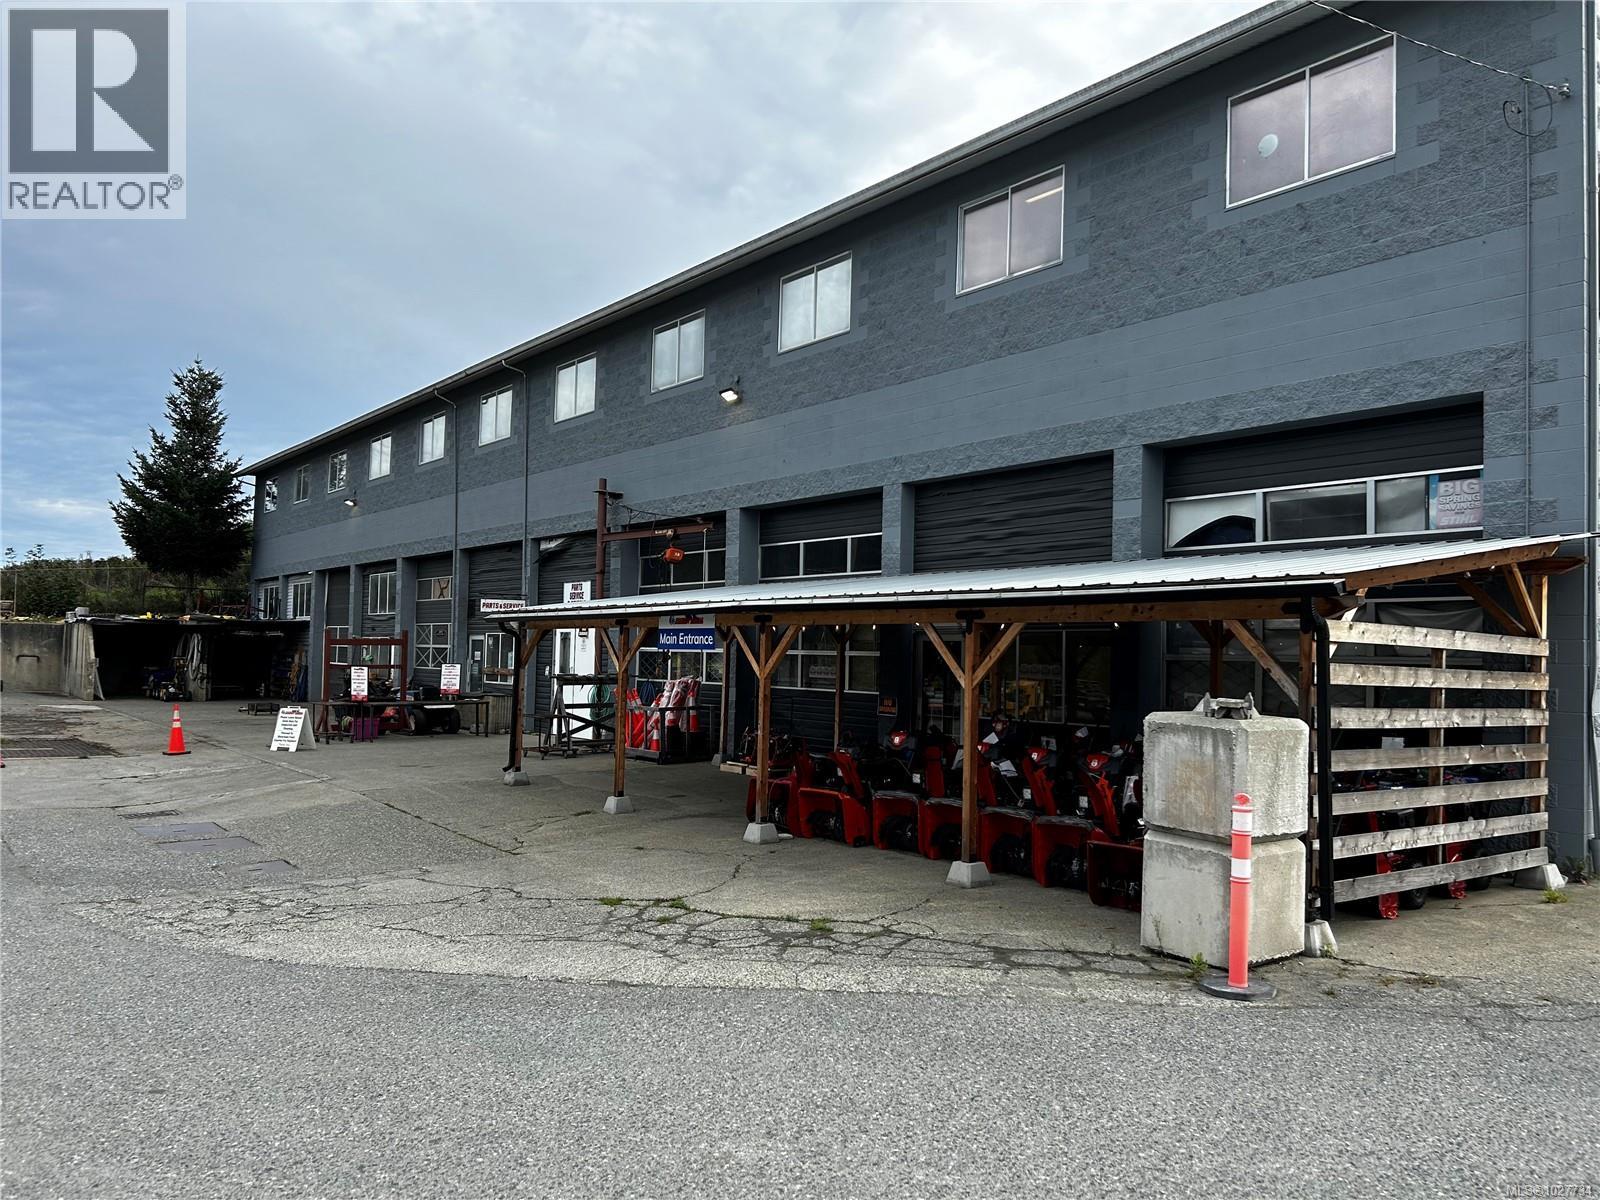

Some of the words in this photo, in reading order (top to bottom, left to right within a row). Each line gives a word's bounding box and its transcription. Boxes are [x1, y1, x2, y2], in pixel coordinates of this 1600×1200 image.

[1439, 479, 1480, 497] BIG
[1439, 494, 1481, 504] SPRING
[1439, 502, 1481, 512] SAVINGS
[1439, 514, 1478, 526] STIHL
[571, 583, 583, 591] PARTS
[569, 591, 584, 600] SERVICE
[659, 632, 677, 644] Main
[679, 632, 714, 645] Entrance
